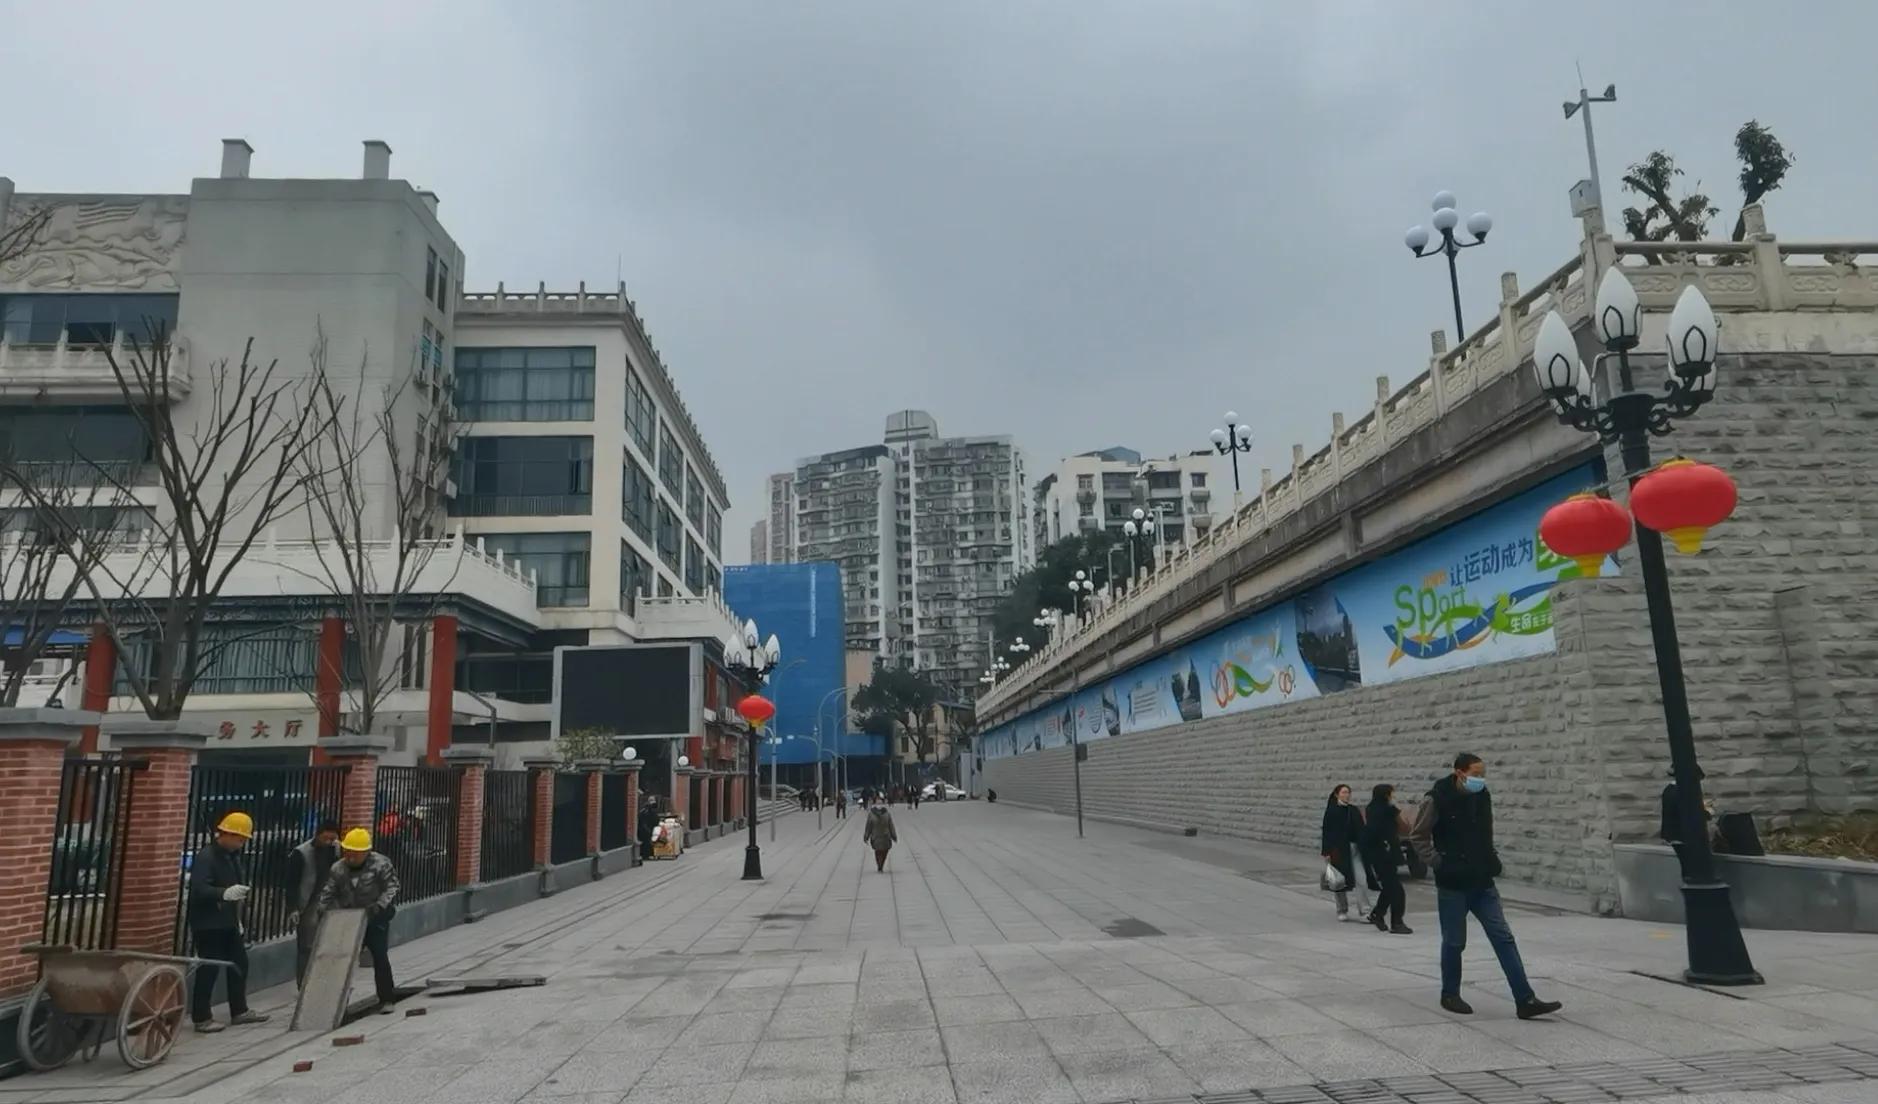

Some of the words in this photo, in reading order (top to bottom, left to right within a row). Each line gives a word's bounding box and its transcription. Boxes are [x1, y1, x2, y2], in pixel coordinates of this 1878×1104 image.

[1450, 538, 1533, 586] 让运动成为
[1394, 584, 1466, 636] Sport
[218, 719, 304, 740] 务大厅
